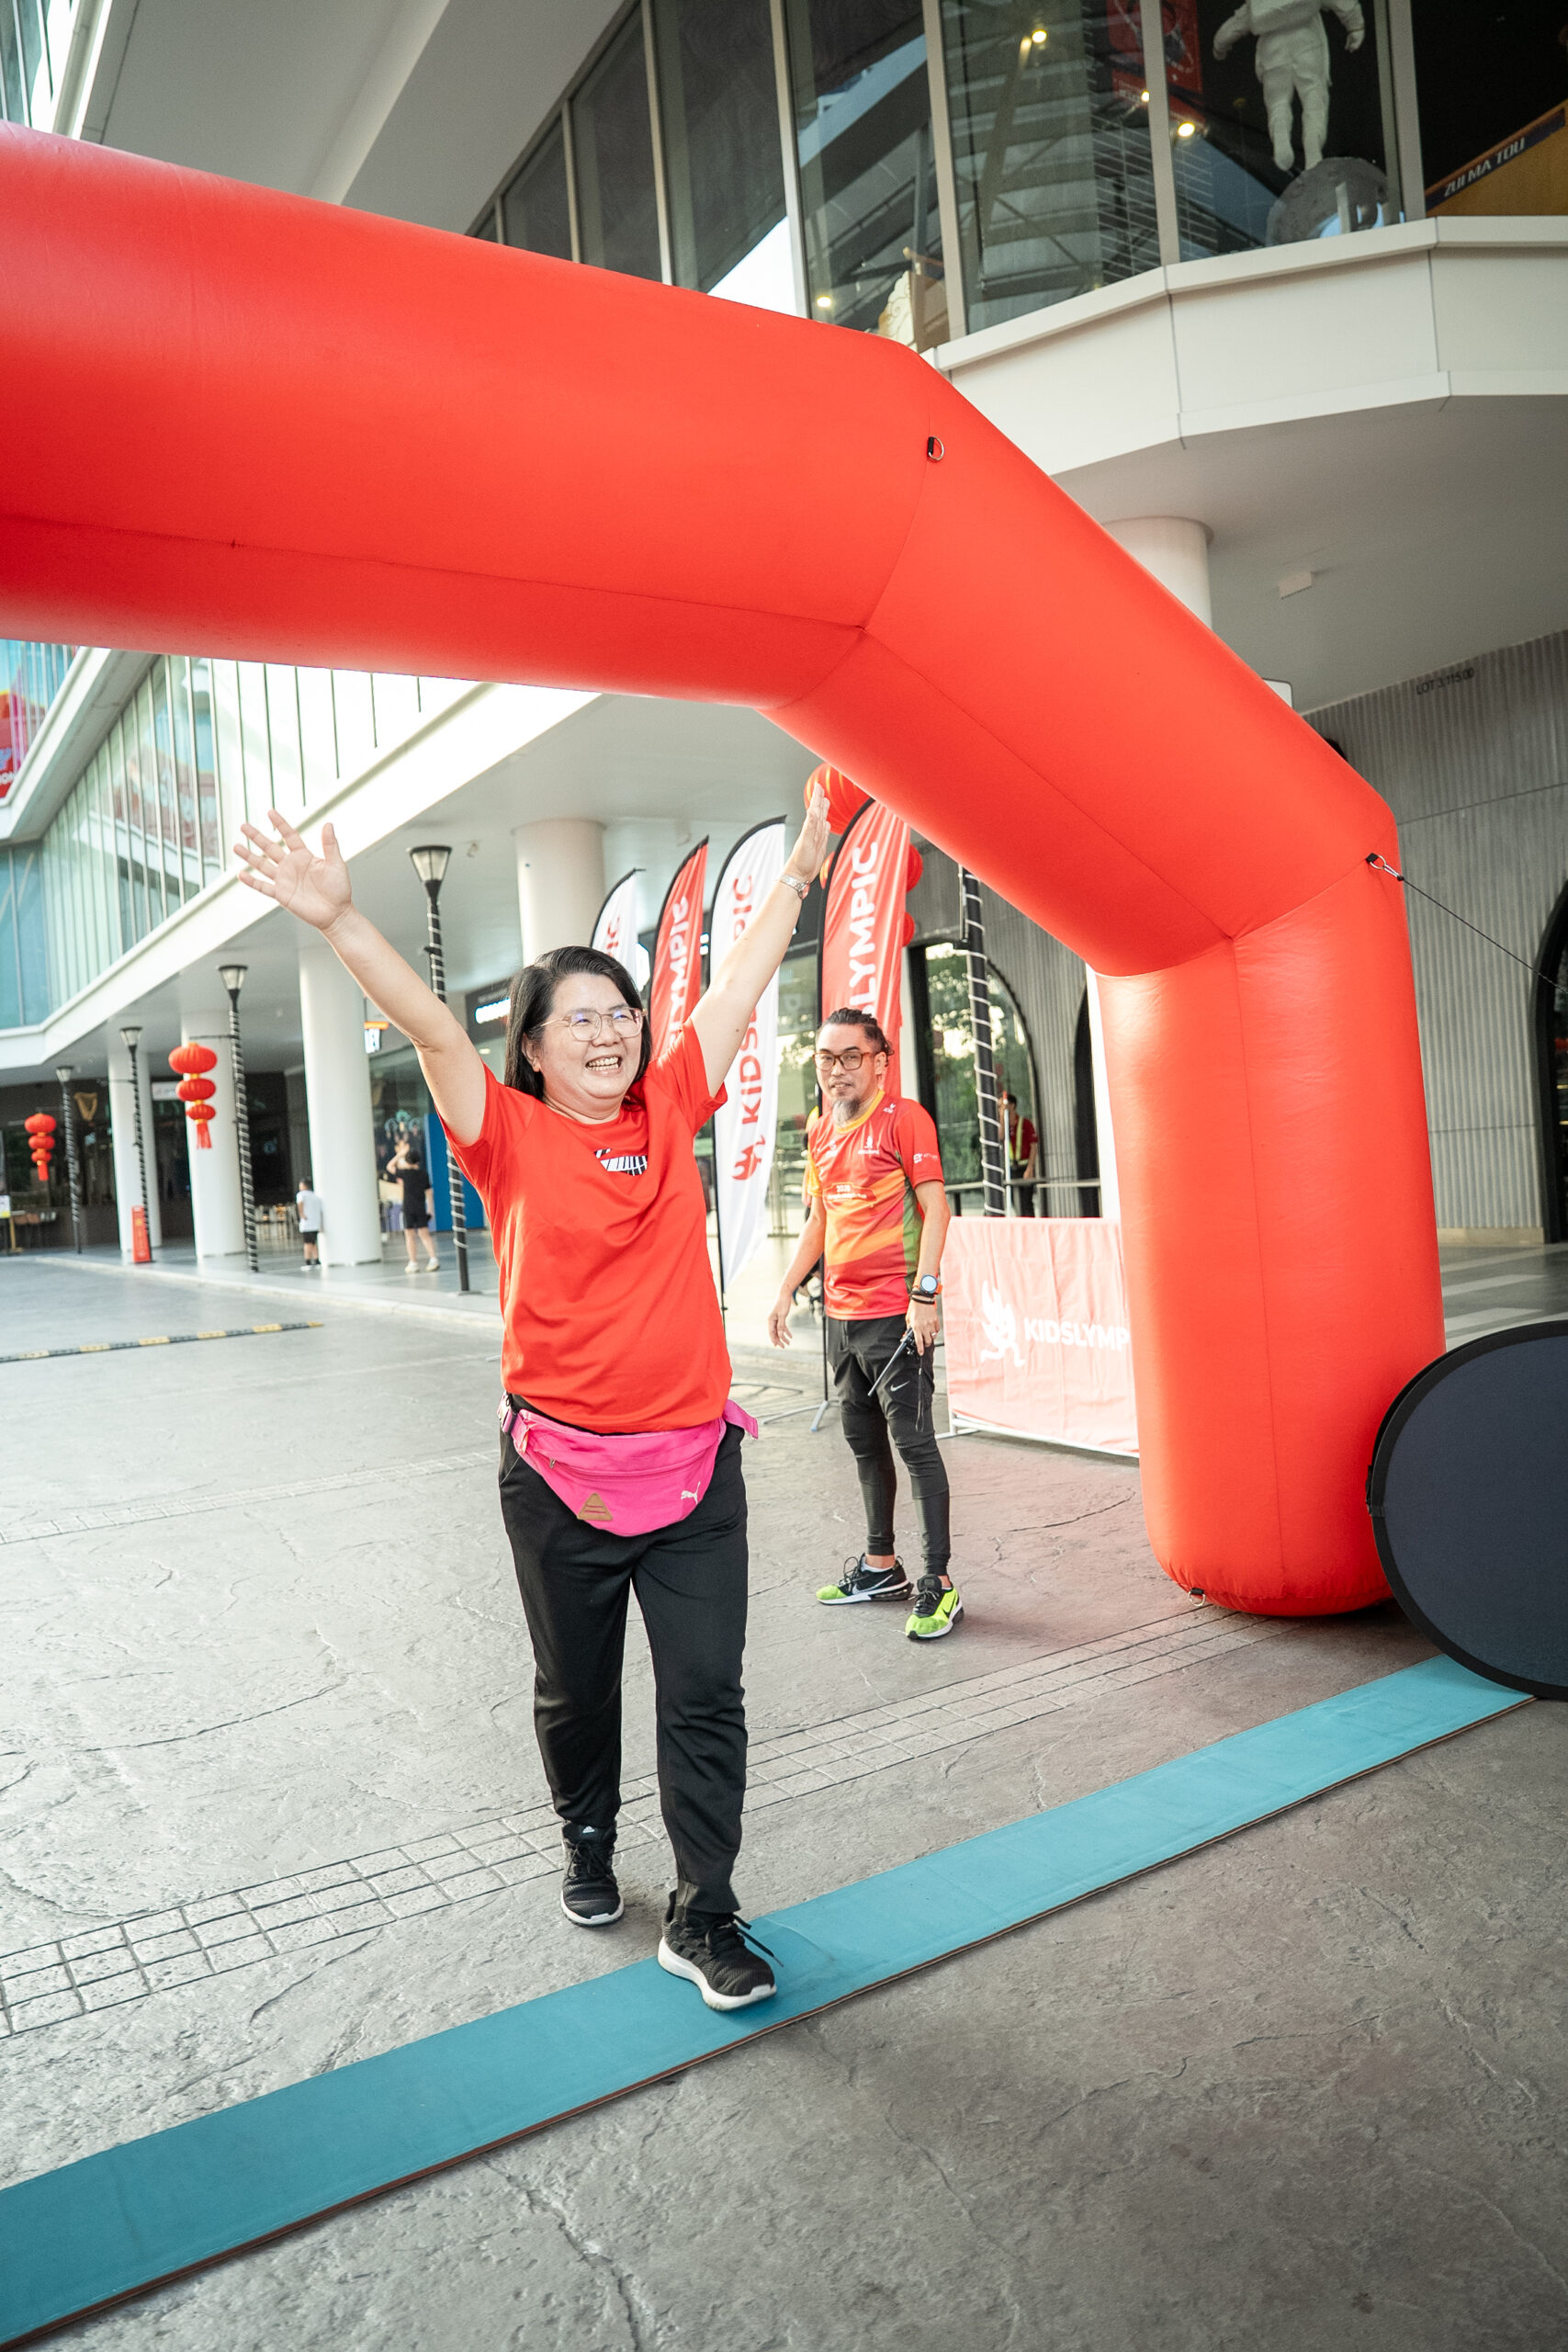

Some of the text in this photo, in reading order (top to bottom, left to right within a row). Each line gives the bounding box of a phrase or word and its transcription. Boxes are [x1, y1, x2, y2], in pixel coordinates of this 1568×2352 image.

[1468, 159, 1492, 183] MA
[1495, 137, 1525, 164] TOU
[1416, 679, 1434, 695] LOT
[850, 842, 878, 1018] LYMPIC
[669, 896, 689, 1047] LYMPIC
[1023, 1317, 1130, 1351] KIDSLYMP
